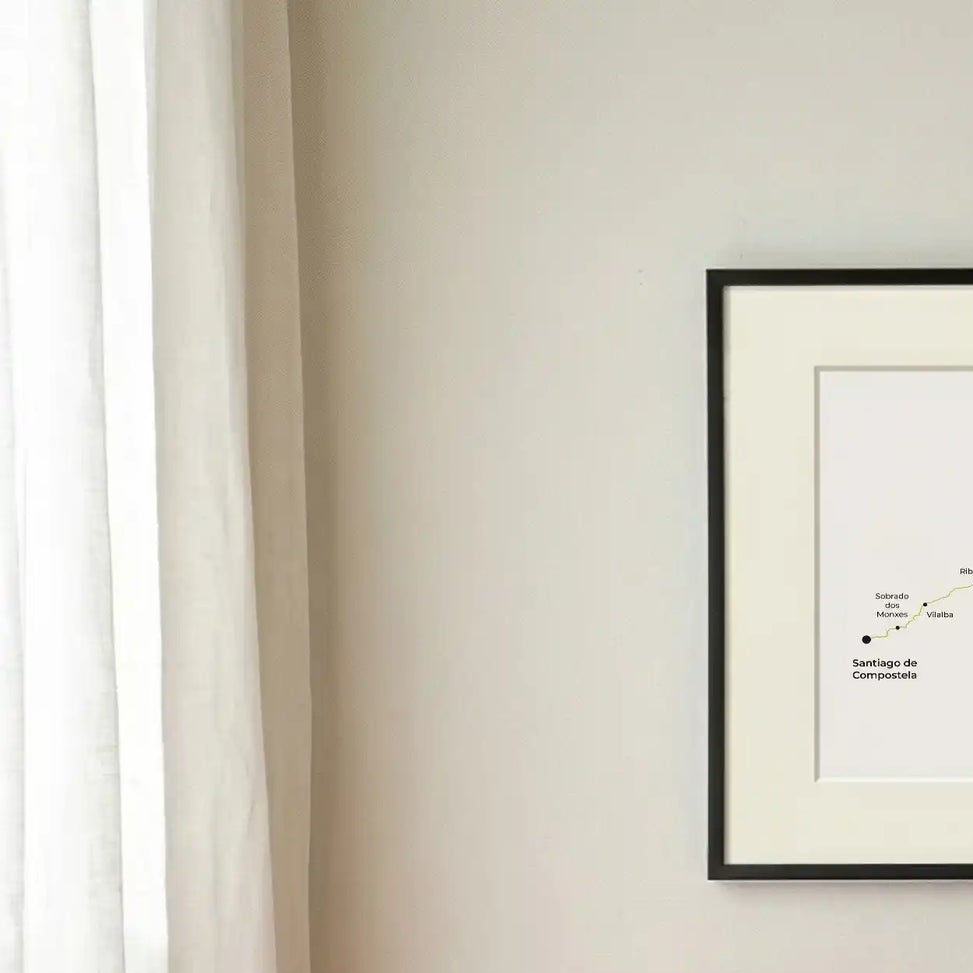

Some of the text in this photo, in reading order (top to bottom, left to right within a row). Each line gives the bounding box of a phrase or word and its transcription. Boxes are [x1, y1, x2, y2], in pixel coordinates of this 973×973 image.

[875, 592, 910, 600] Sobrado
[884, 601, 900, 609] dos
[926, 611, 954, 619] Vilalba
[852, 658, 918, 670] Santiago de
[852, 670, 918, 681] Compostela
